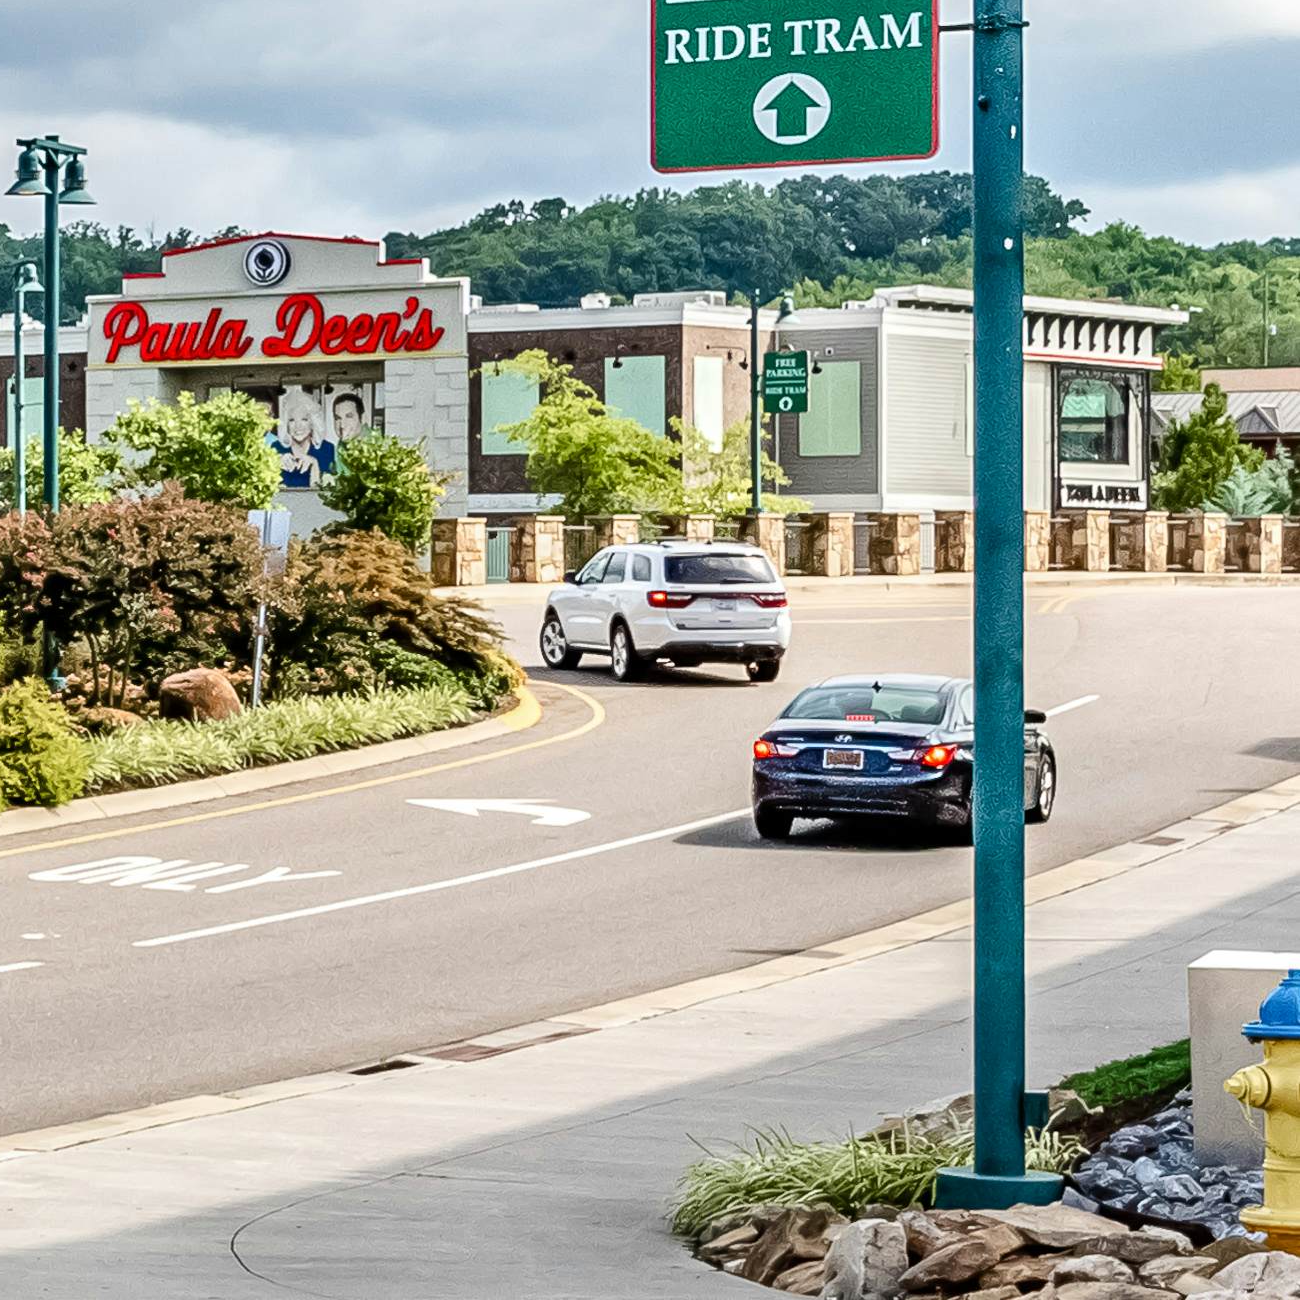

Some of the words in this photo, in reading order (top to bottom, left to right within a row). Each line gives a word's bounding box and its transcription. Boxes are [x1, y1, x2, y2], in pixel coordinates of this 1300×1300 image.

[664, 22, 772, 64] RIDE
[783, 12, 923, 56] TRAM
[103, 301, 254, 364] Paula
[261, 292, 445, 357] Deen's
[27, 854, 344, 894] ONLY
